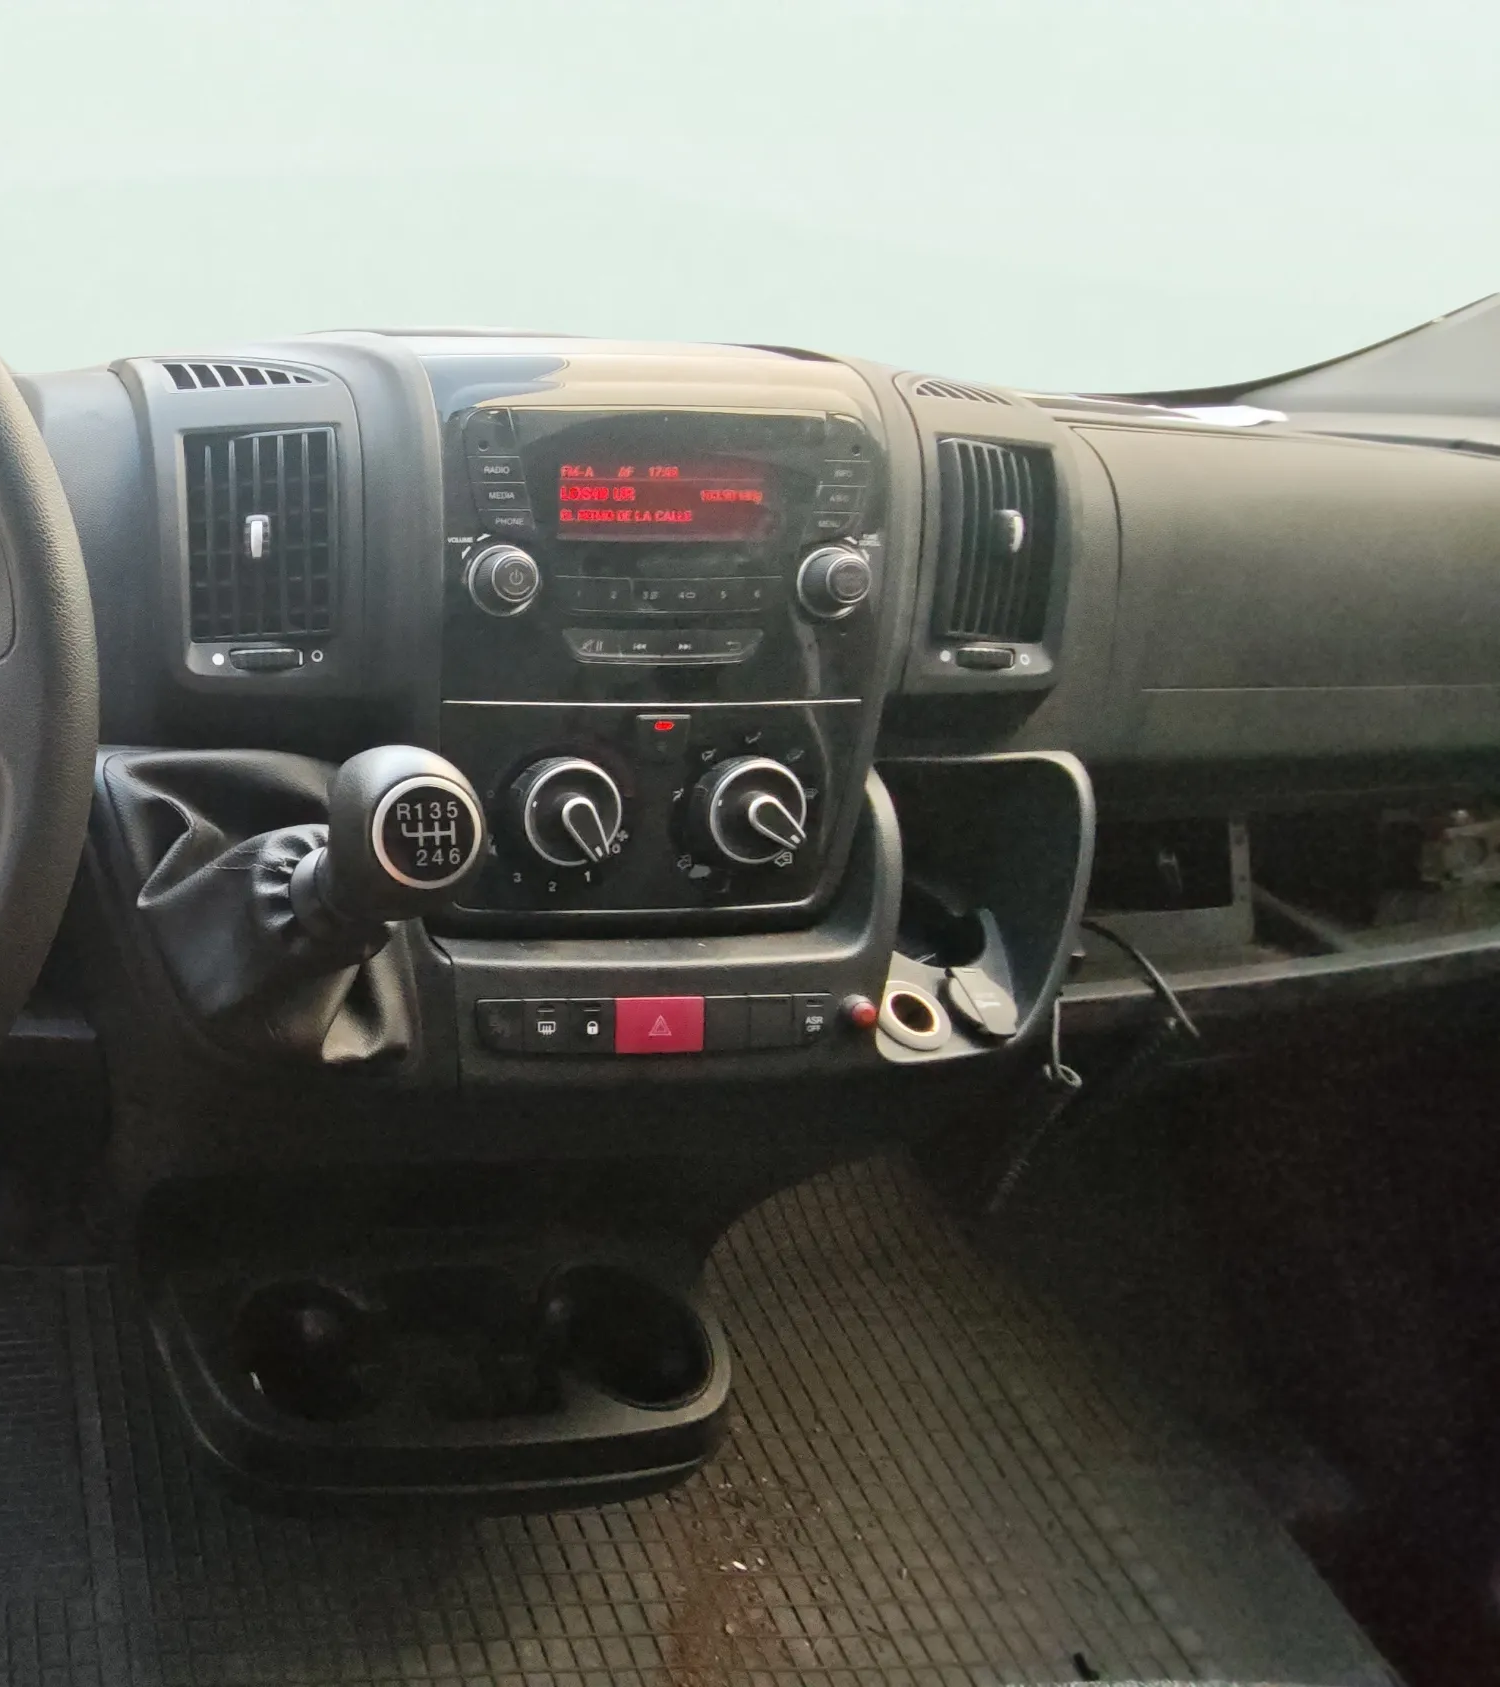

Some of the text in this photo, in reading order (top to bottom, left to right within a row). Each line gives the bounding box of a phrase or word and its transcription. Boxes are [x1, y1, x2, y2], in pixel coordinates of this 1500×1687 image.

[484, 466, 510, 474] RADIO
[488, 491, 515, 499] MEDIA
[495, 517, 525, 526] PHONE
[447, 536, 474, 544] VOLUME
[610, 590, 618, 600] 2
[719, 590, 727, 599] 5
[753, 589, 761, 599] 6
[513, 872, 522, 883] 3
[584, 871, 591, 882] 1
[548, 881, 557, 892] 2
[805, 1016, 824, 1025] ASR
